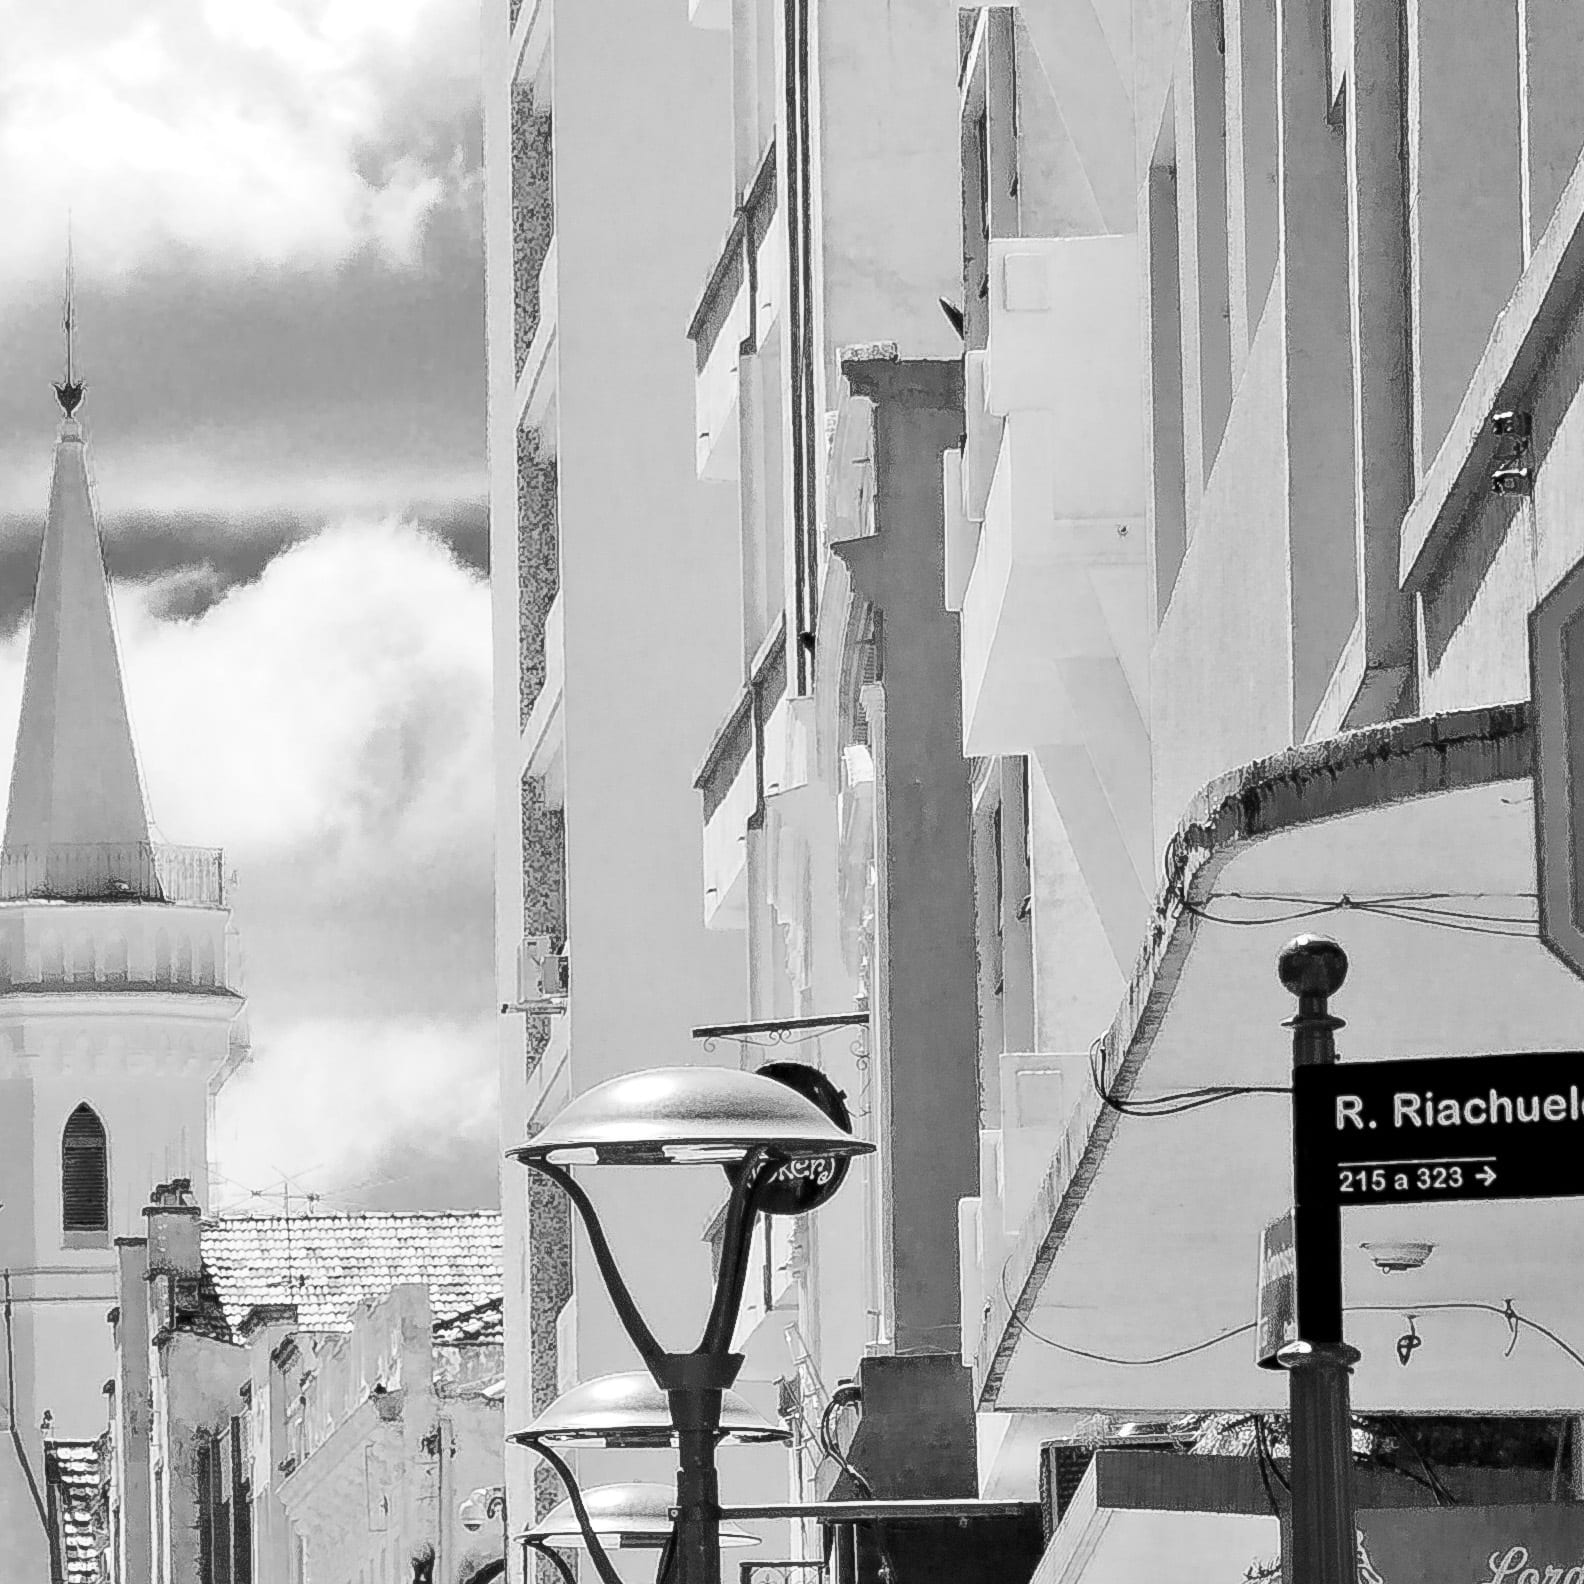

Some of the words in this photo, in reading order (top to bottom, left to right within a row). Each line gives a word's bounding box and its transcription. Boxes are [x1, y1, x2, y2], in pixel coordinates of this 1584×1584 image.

[1335, 1095, 1377, 1130] R.
[1394, 1085, 1584, 1128] Riachuel
[1339, 1169, 1387, 1192] 215
[1394, 1173, 1409, 1190] a
[1416, 1166, 1464, 1190] 323
